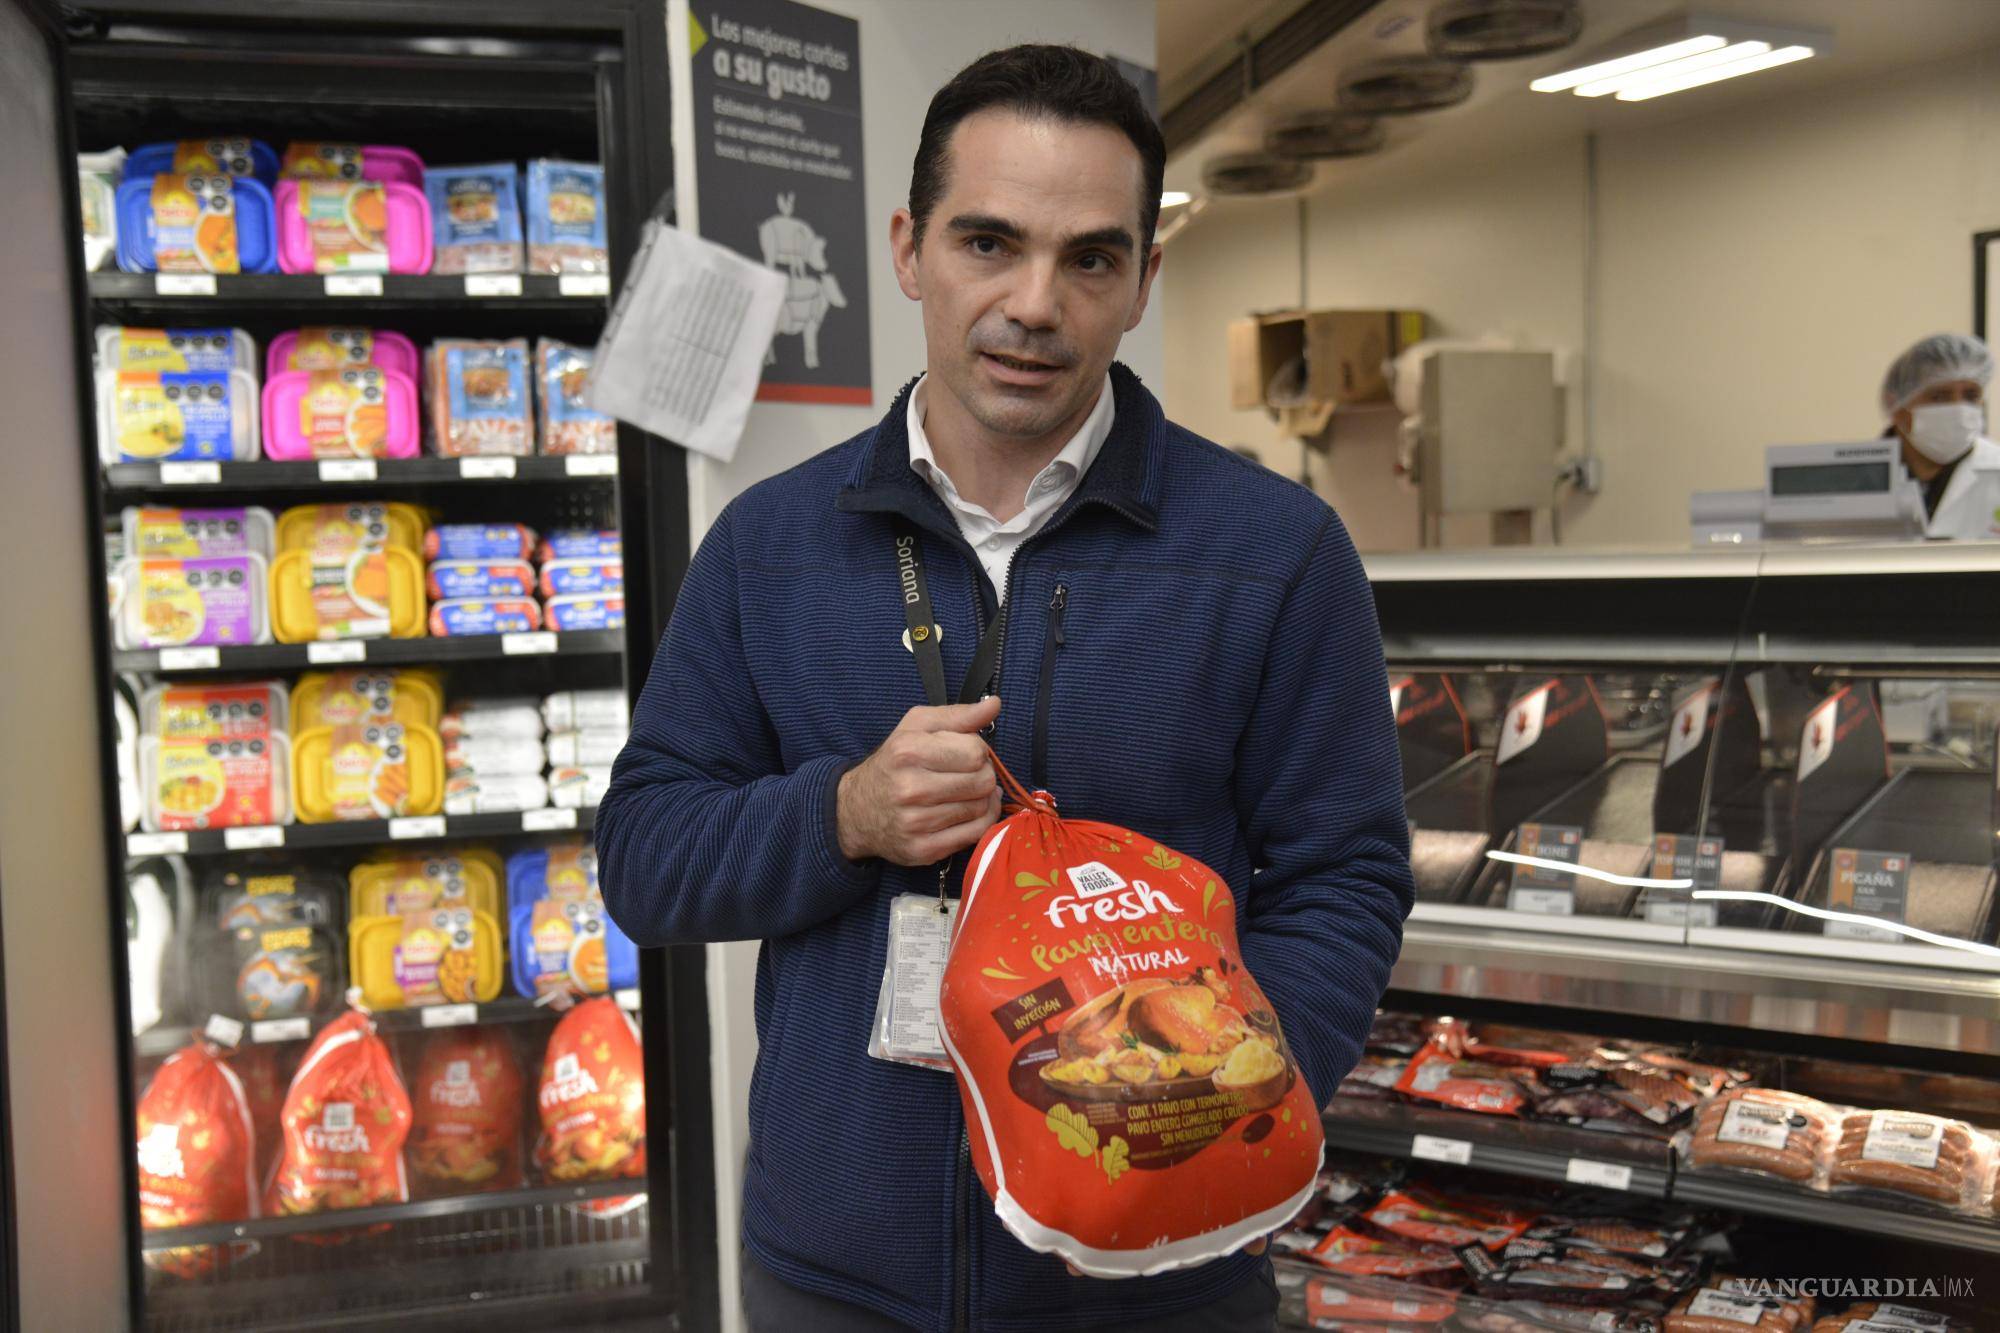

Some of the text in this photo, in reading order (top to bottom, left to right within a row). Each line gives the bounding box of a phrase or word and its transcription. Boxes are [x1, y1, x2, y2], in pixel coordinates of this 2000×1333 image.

[711, 13, 741, 43] Los
[713, 50, 831, 101] a su gusto
[896, 535, 920, 604] Soriana
[1076, 871, 1108, 883] VALLEY
[1043, 879, 1184, 928] fresh
[1088, 947, 1191, 977] NATURAL
[1018, 993, 1036, 1010] SIN
[1127, 1103, 1249, 1136] PAVO ENTERO CONGELADO CRUDO
[1158, 1100, 1180, 1116] PAVO
[1180, 1097, 1196, 1112] CON
[1160, 1123, 1223, 1147] SIN MENUDENCIAS
